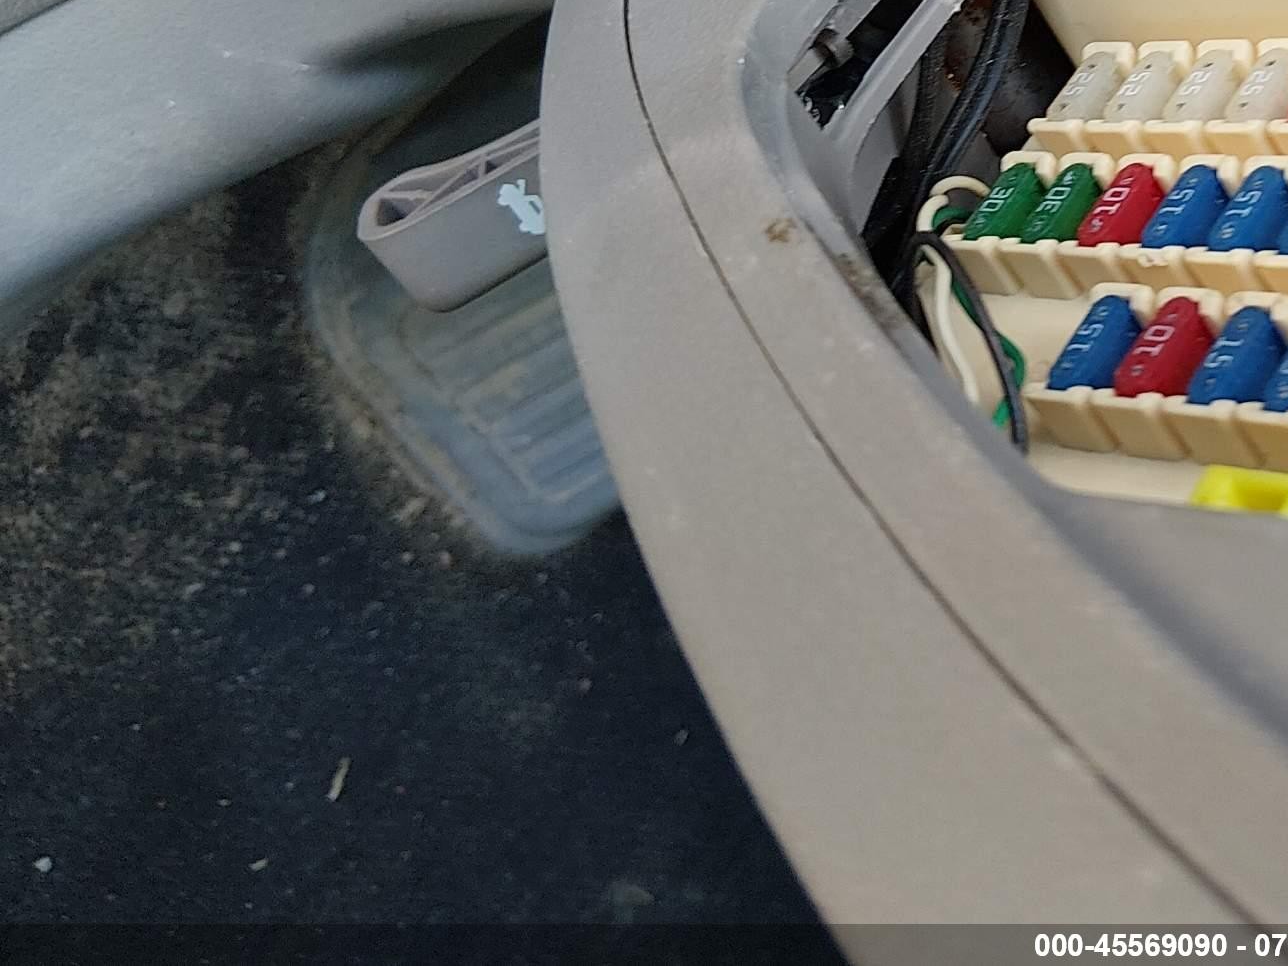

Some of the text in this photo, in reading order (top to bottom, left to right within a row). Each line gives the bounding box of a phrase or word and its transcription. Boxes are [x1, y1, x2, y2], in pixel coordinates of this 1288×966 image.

[980, 186, 1015, 213] 30
[1034, 185, 1072, 214] 30
[1093, 187, 1131, 216] 10
[1158, 188, 1196, 216] 15
[1224, 190, 1263, 218] 15
[1067, 323, 1104, 353] 15
[1134, 324, 1175, 356] 10
[1203, 337, 1244, 369] 15
